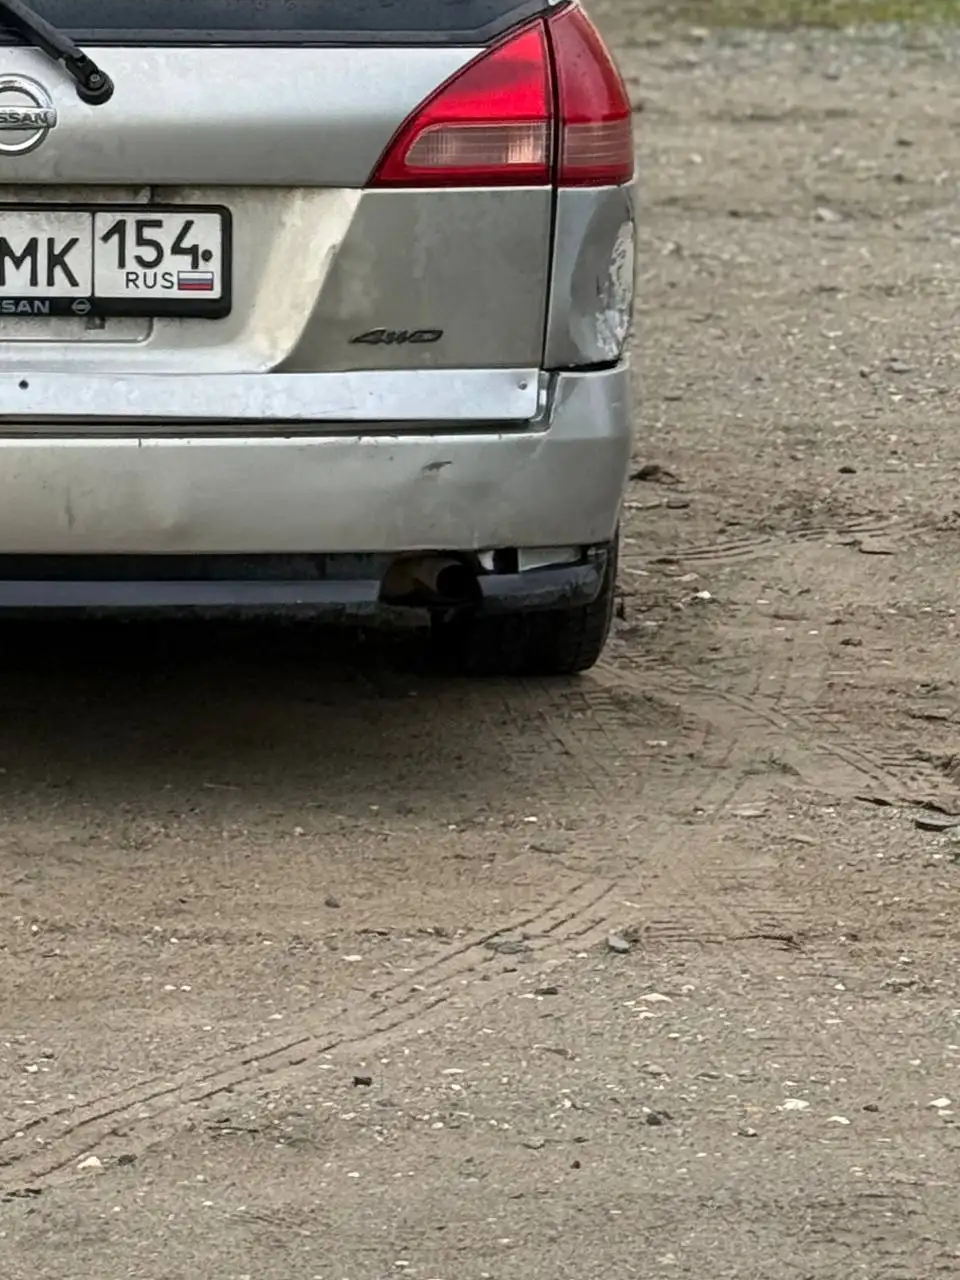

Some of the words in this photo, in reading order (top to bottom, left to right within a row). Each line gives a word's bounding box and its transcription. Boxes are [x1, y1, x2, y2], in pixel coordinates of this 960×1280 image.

[100, 219, 200, 271] 154
[125, 271, 175, 290] RUS
[347, 329, 444, 345] 4WD
